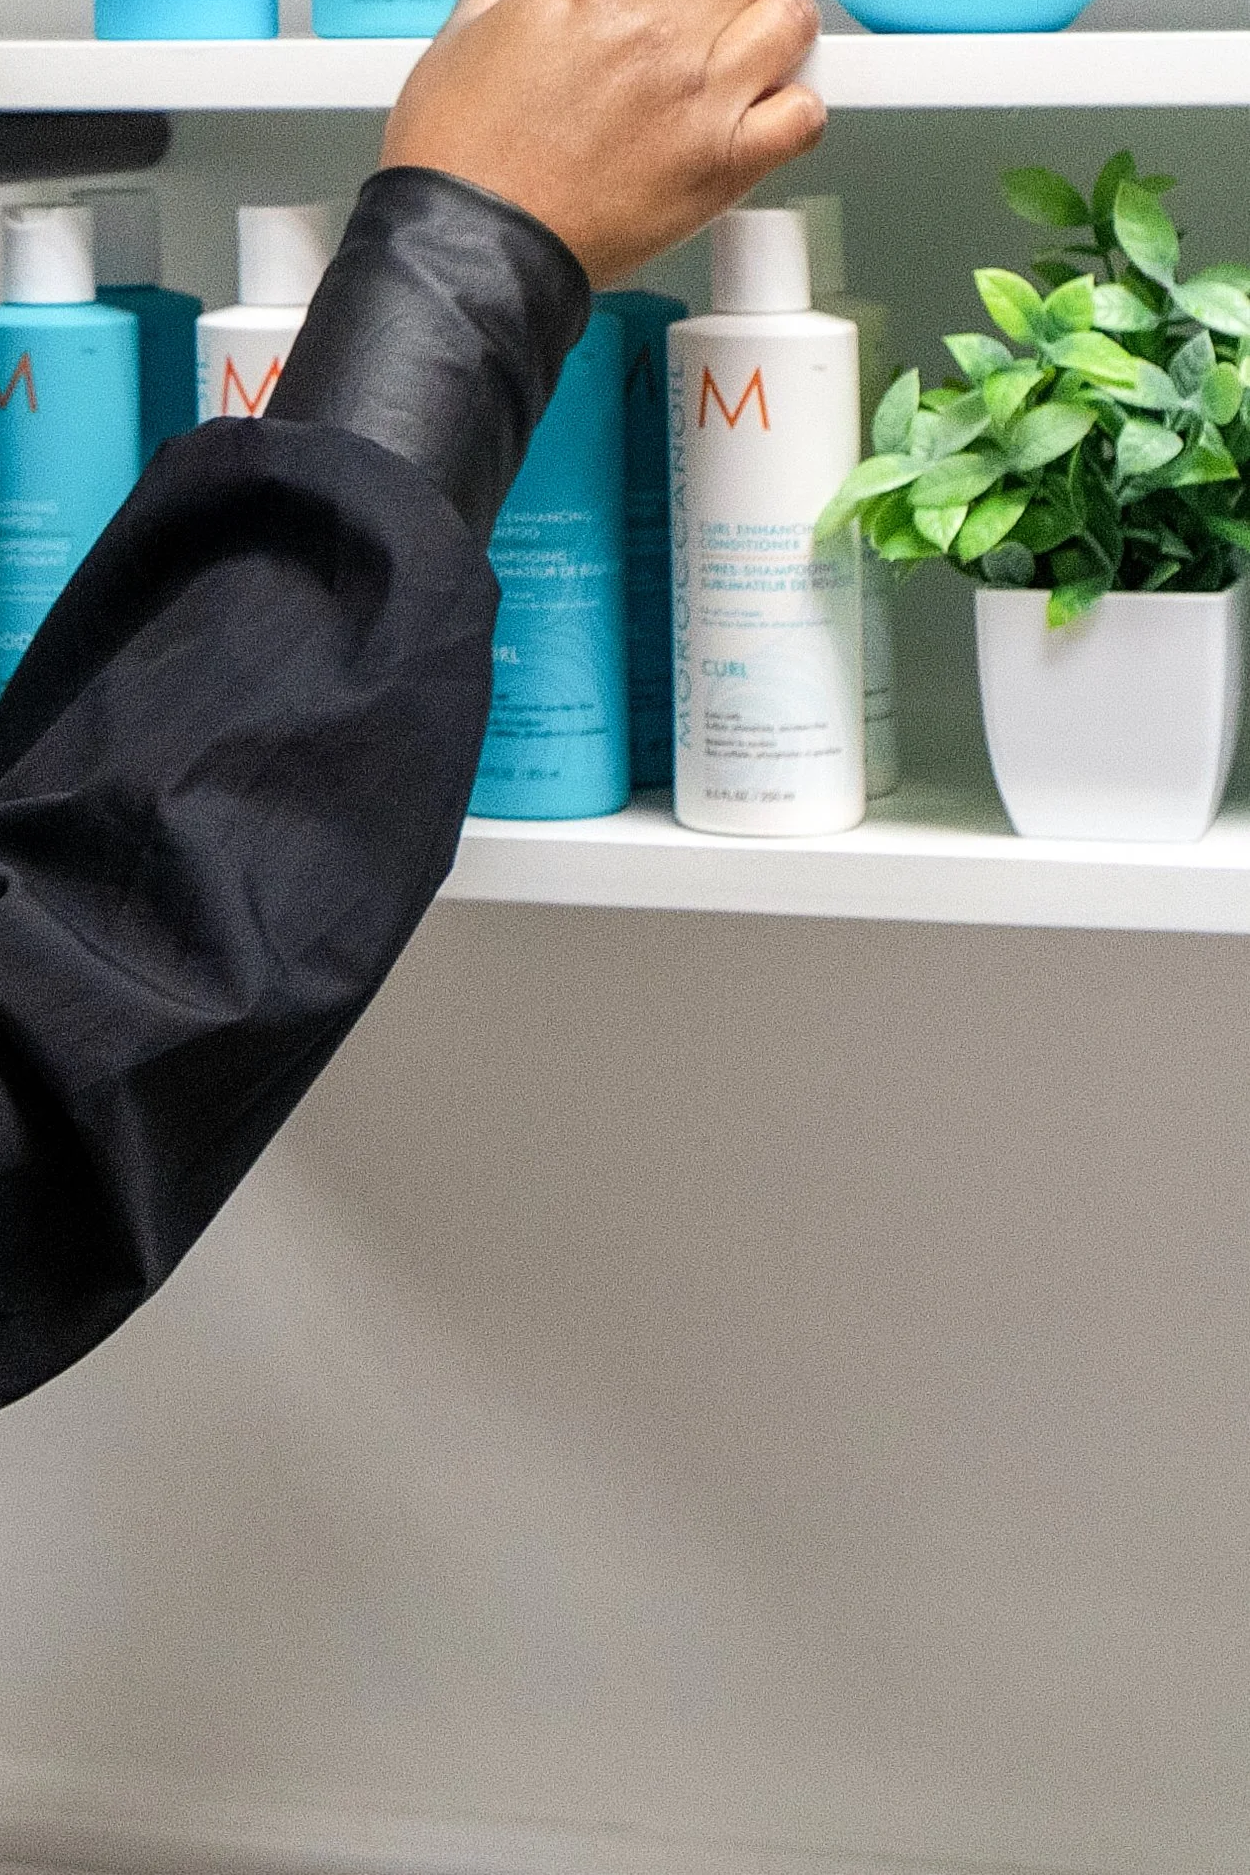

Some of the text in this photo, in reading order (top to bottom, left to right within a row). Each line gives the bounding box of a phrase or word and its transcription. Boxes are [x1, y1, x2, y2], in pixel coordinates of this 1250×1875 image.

[222, 353, 284, 417] M
[699, 365, 770, 431] M
[702, 659, 748, 679] CURL
